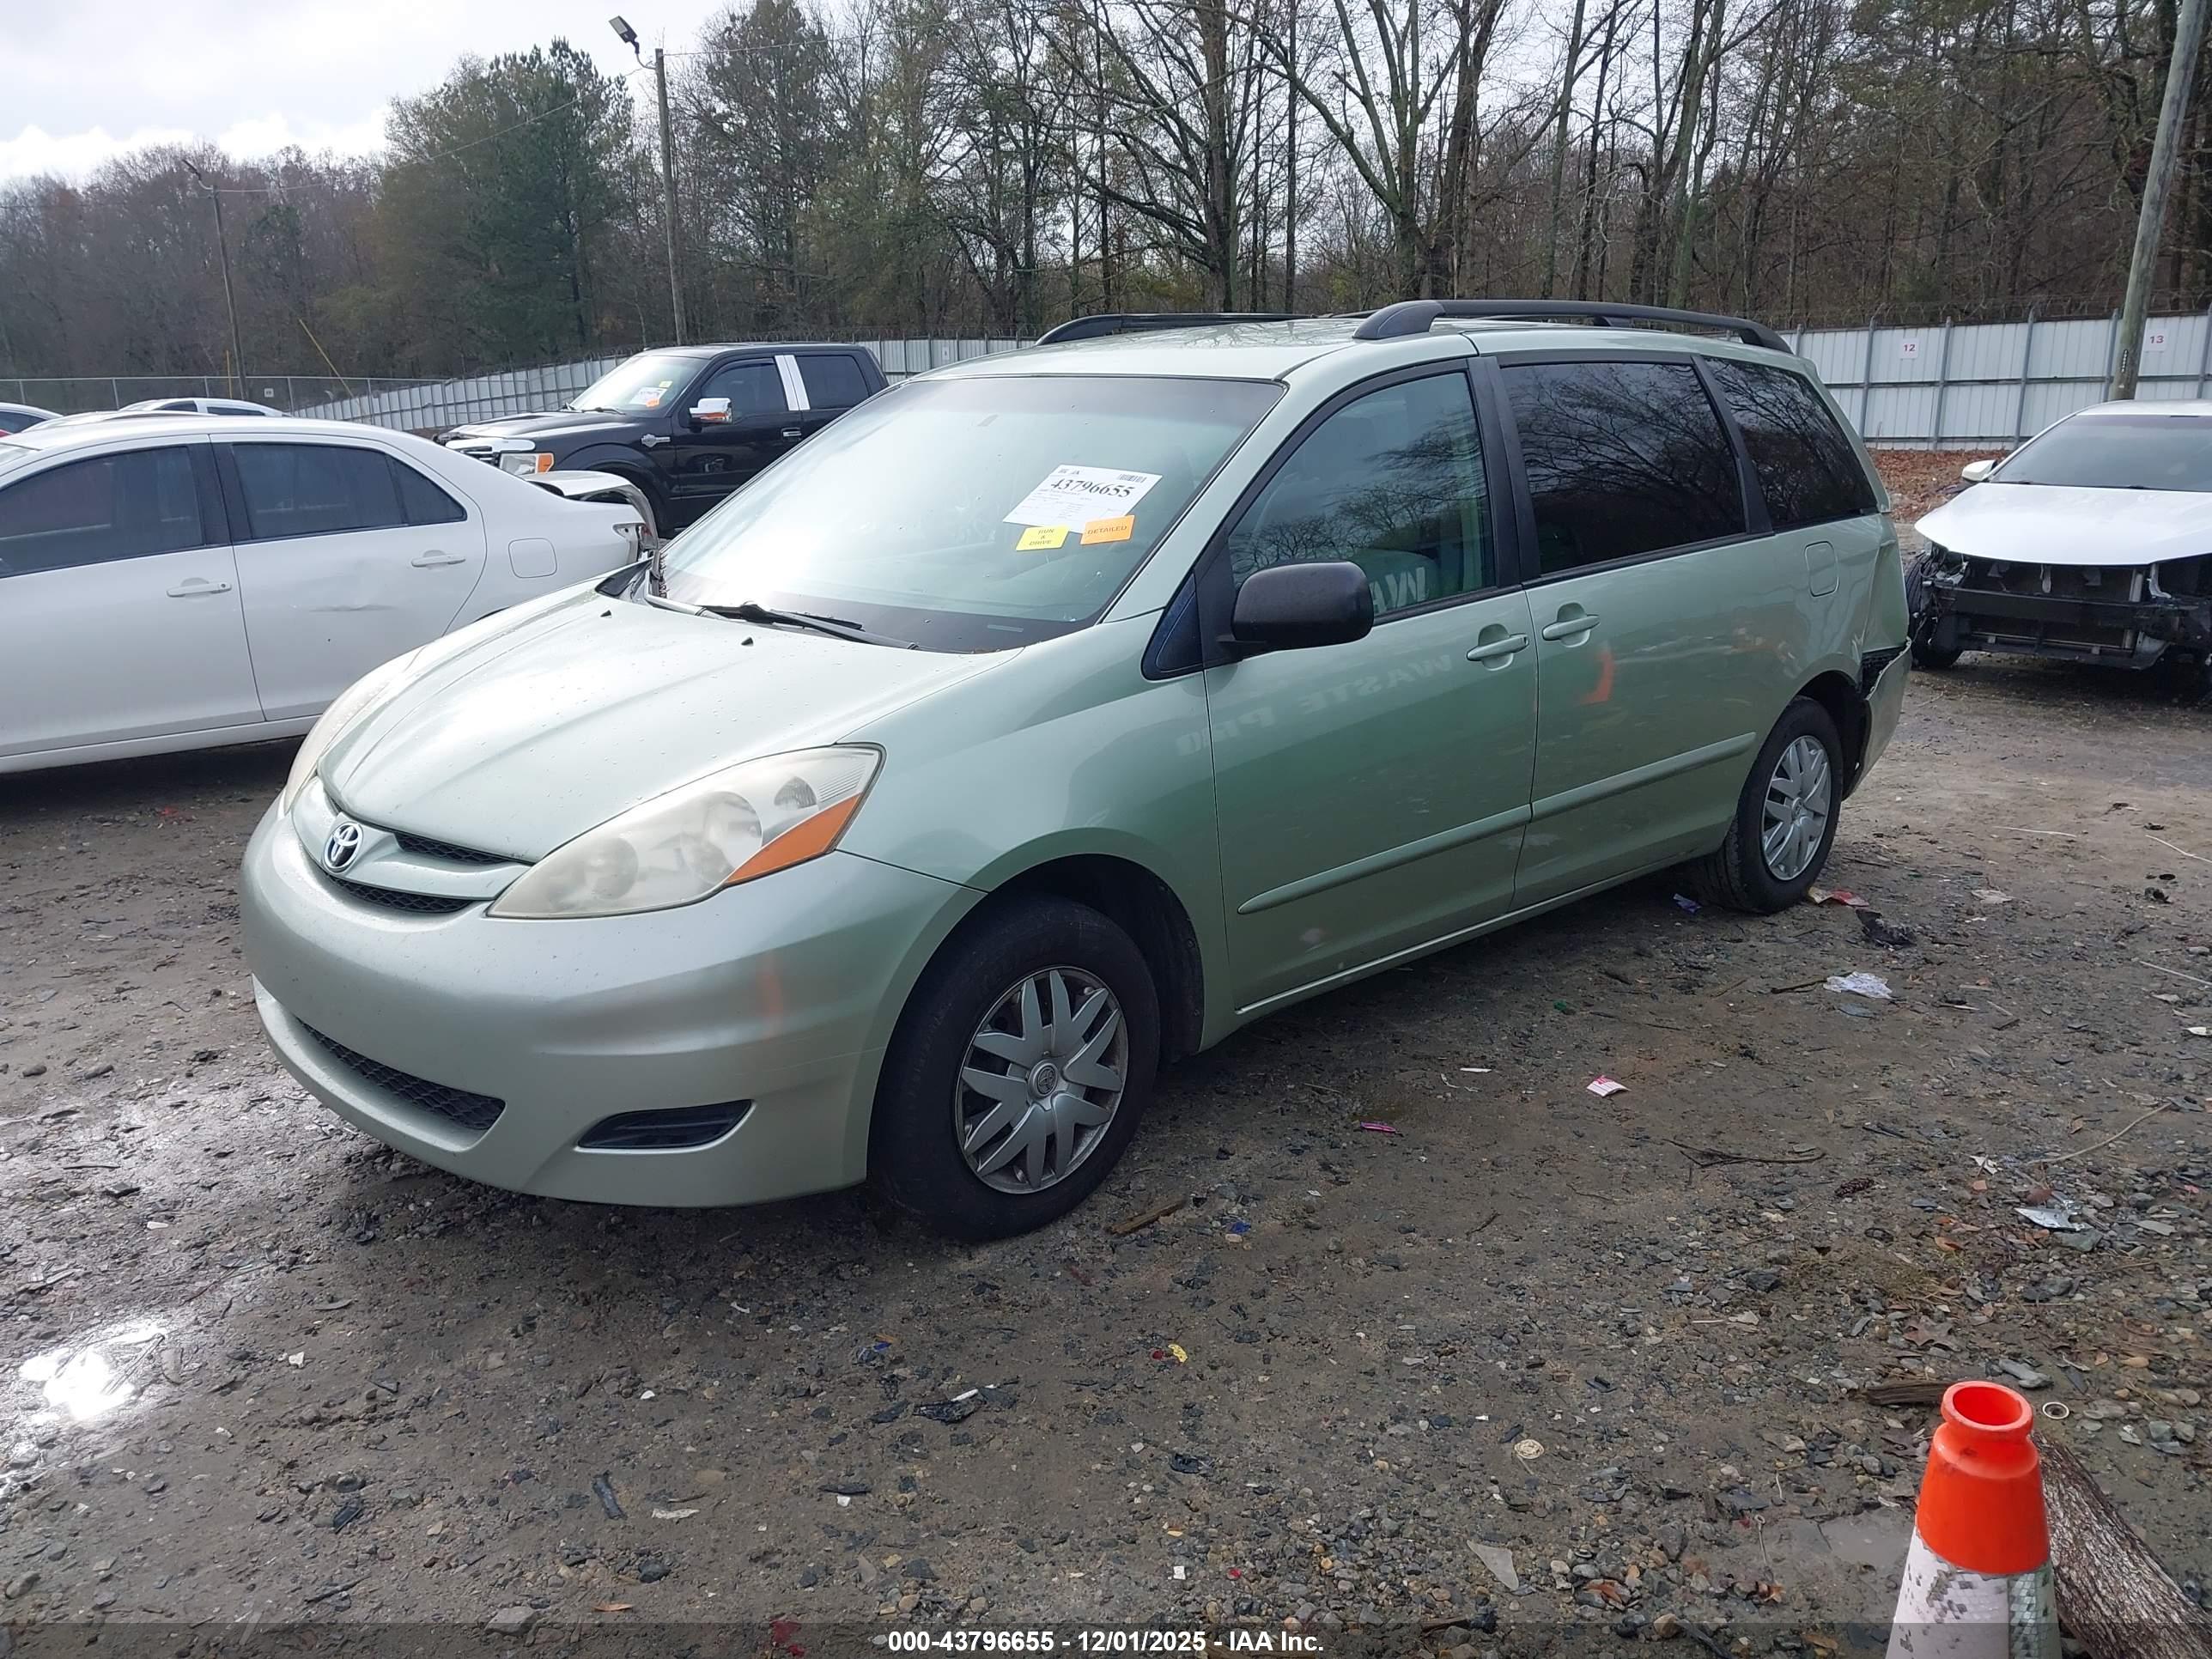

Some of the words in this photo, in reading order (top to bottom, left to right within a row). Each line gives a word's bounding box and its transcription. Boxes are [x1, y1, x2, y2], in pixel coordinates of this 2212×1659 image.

[2149, 335, 2165, 344] 13
[1904, 343, 1916, 352] 12
[1050, 477, 1135, 498] 43796655
[1087, 526, 1127, 535] DETAILED
